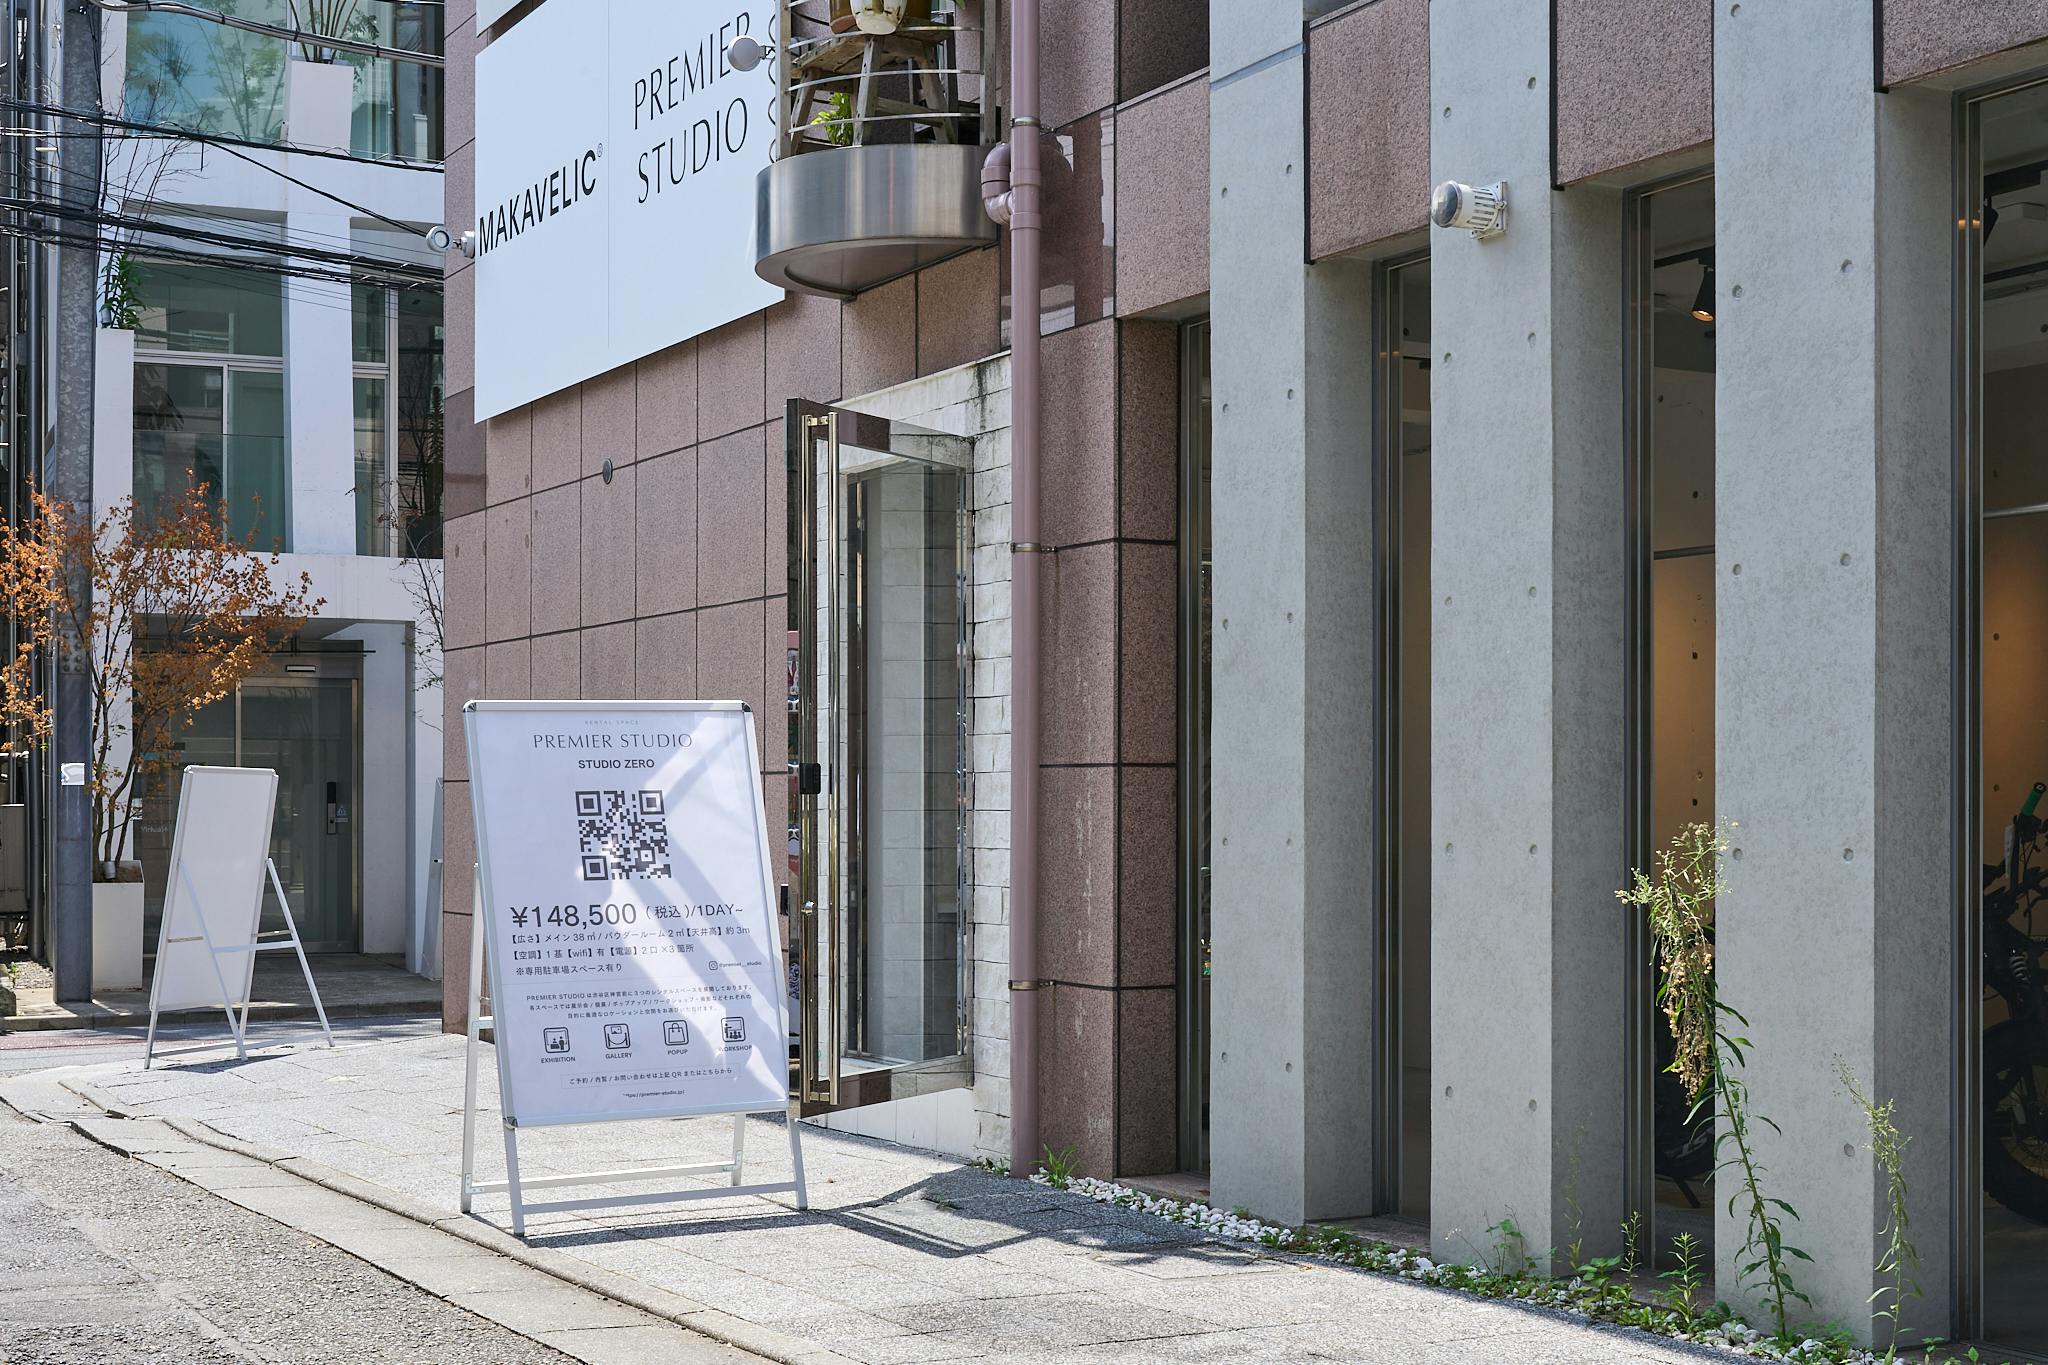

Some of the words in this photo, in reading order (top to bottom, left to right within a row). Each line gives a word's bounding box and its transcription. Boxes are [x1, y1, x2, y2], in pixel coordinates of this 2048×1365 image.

[638, 97, 748, 204] STUDIO
[533, 734, 613, 749] PREMIER
[620, 733, 692, 748] STUDIO
[578, 759, 621, 769] STUDIO
[624, 759, 655, 768] ZERO
[510, 903, 637, 930] ¥148,500
[559, 992, 585, 1000] STUDIO
[605, 1052, 632, 1060] GALLERY
[667, 1048, 688, 1056] POPUP
[541, 1056, 576, 1064] EXHIBITION
